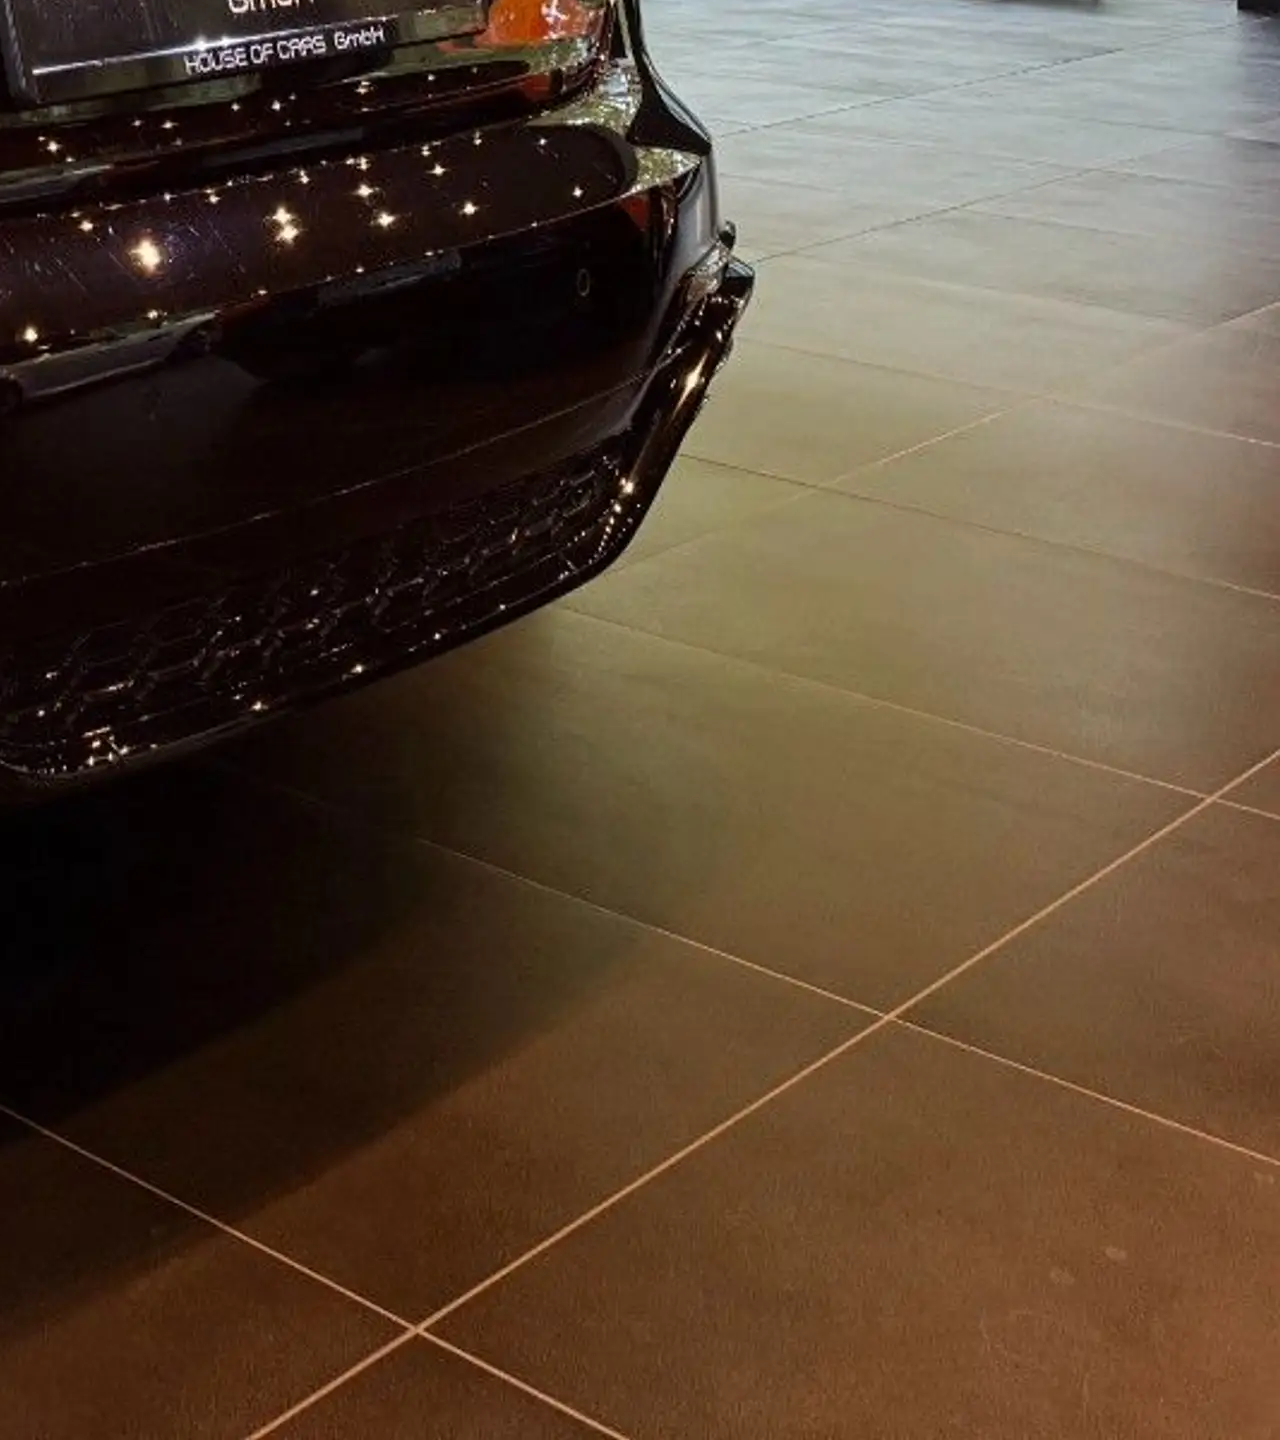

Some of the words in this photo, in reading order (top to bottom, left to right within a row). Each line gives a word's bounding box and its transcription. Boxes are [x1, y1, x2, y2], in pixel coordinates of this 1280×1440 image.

[183, 45, 249, 75] HOUSE
[250, 42, 275, 64] OF
[277, 34, 326, 59] CARS
[333, 25, 385, 51] GmbH
